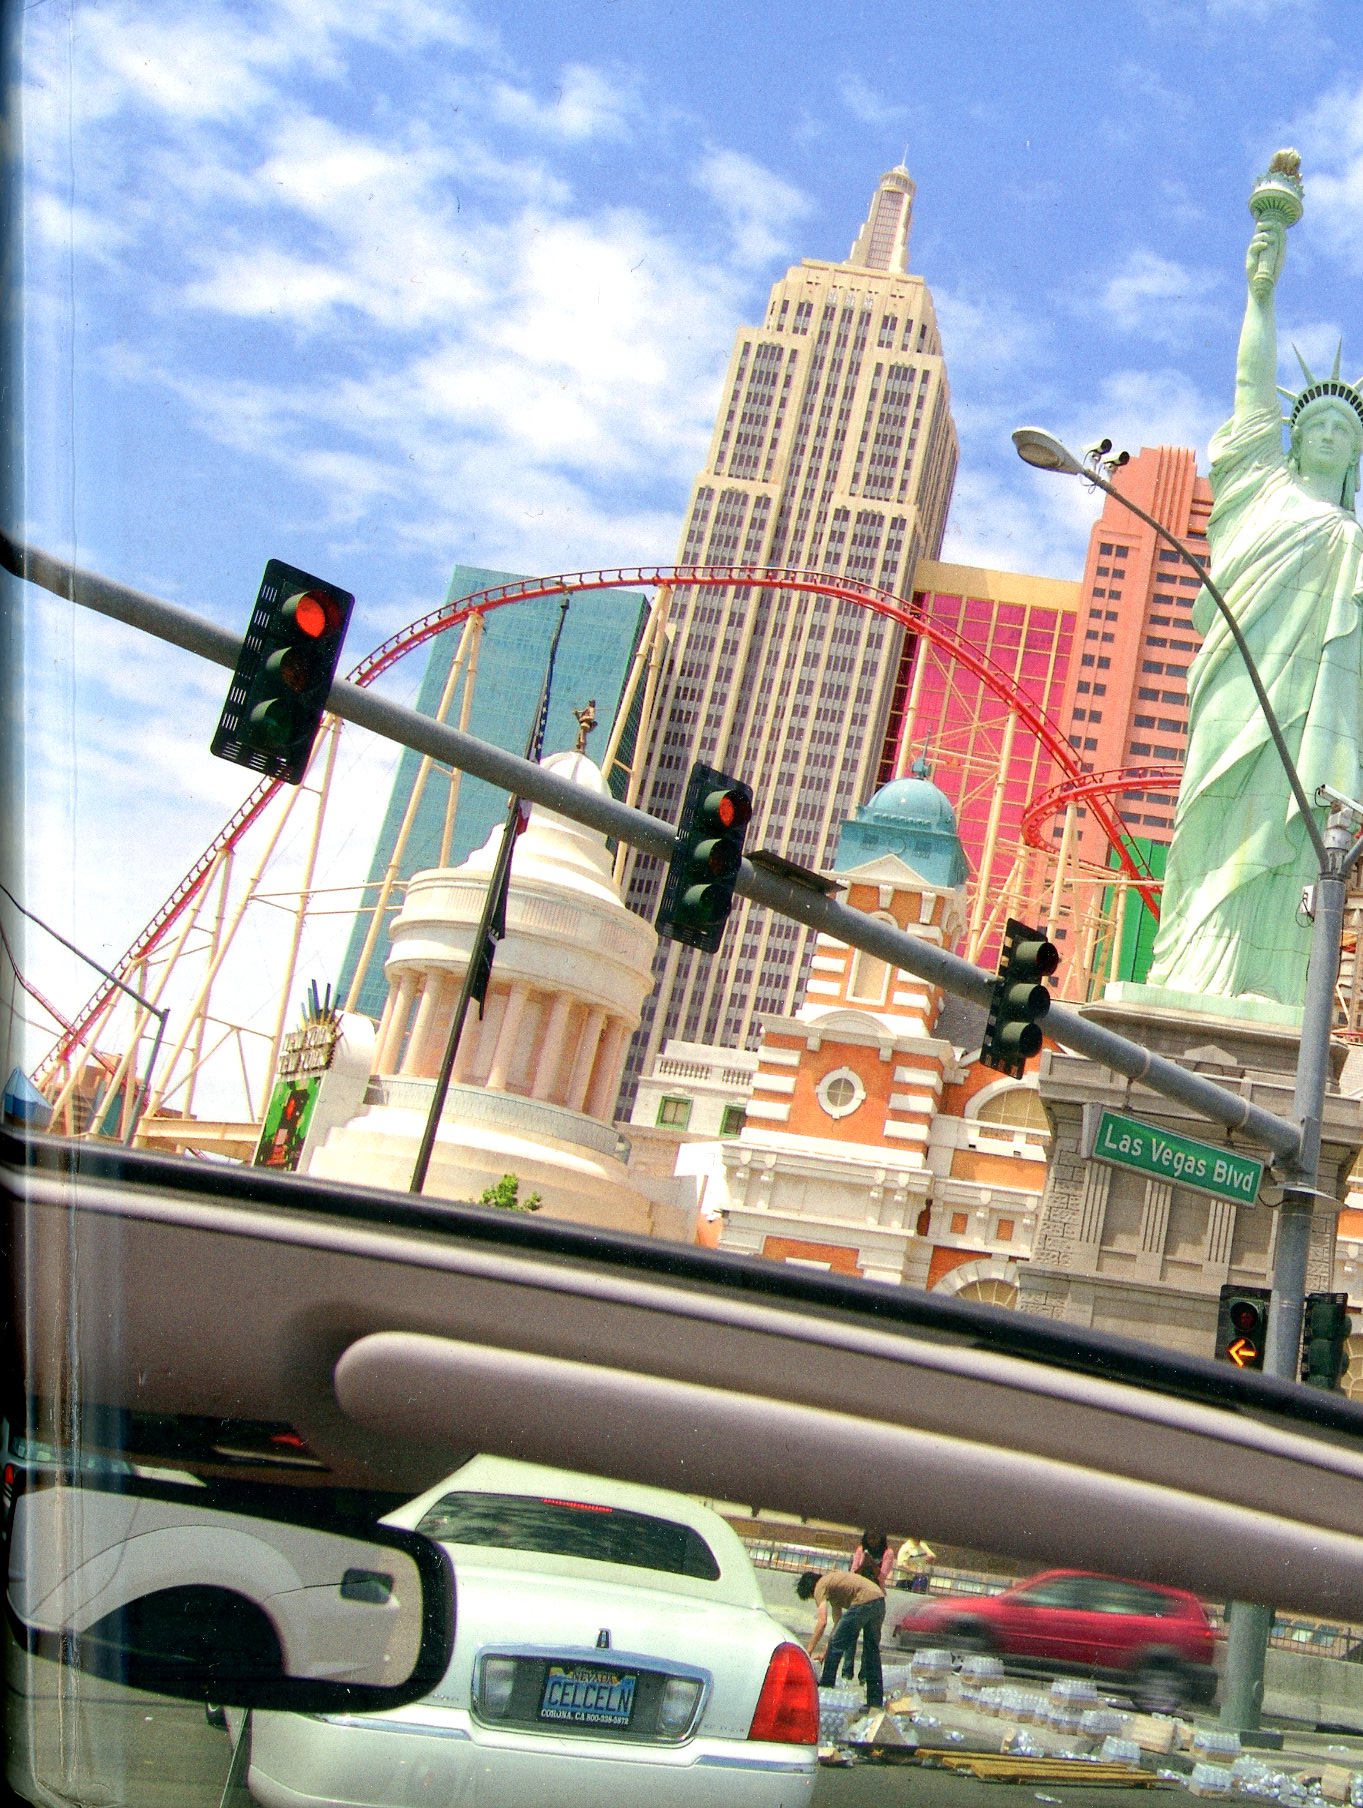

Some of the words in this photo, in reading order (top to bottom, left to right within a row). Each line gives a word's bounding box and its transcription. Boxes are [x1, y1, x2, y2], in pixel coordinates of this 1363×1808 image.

[1104, 1123, 1143, 1157] Las
[1151, 1137, 1206, 1177] Vegas
[1213, 1159, 1255, 1193] Blvd
[572, 1671, 615, 1685] NEVADA
[548, 1681, 631, 1713] CELCELN
